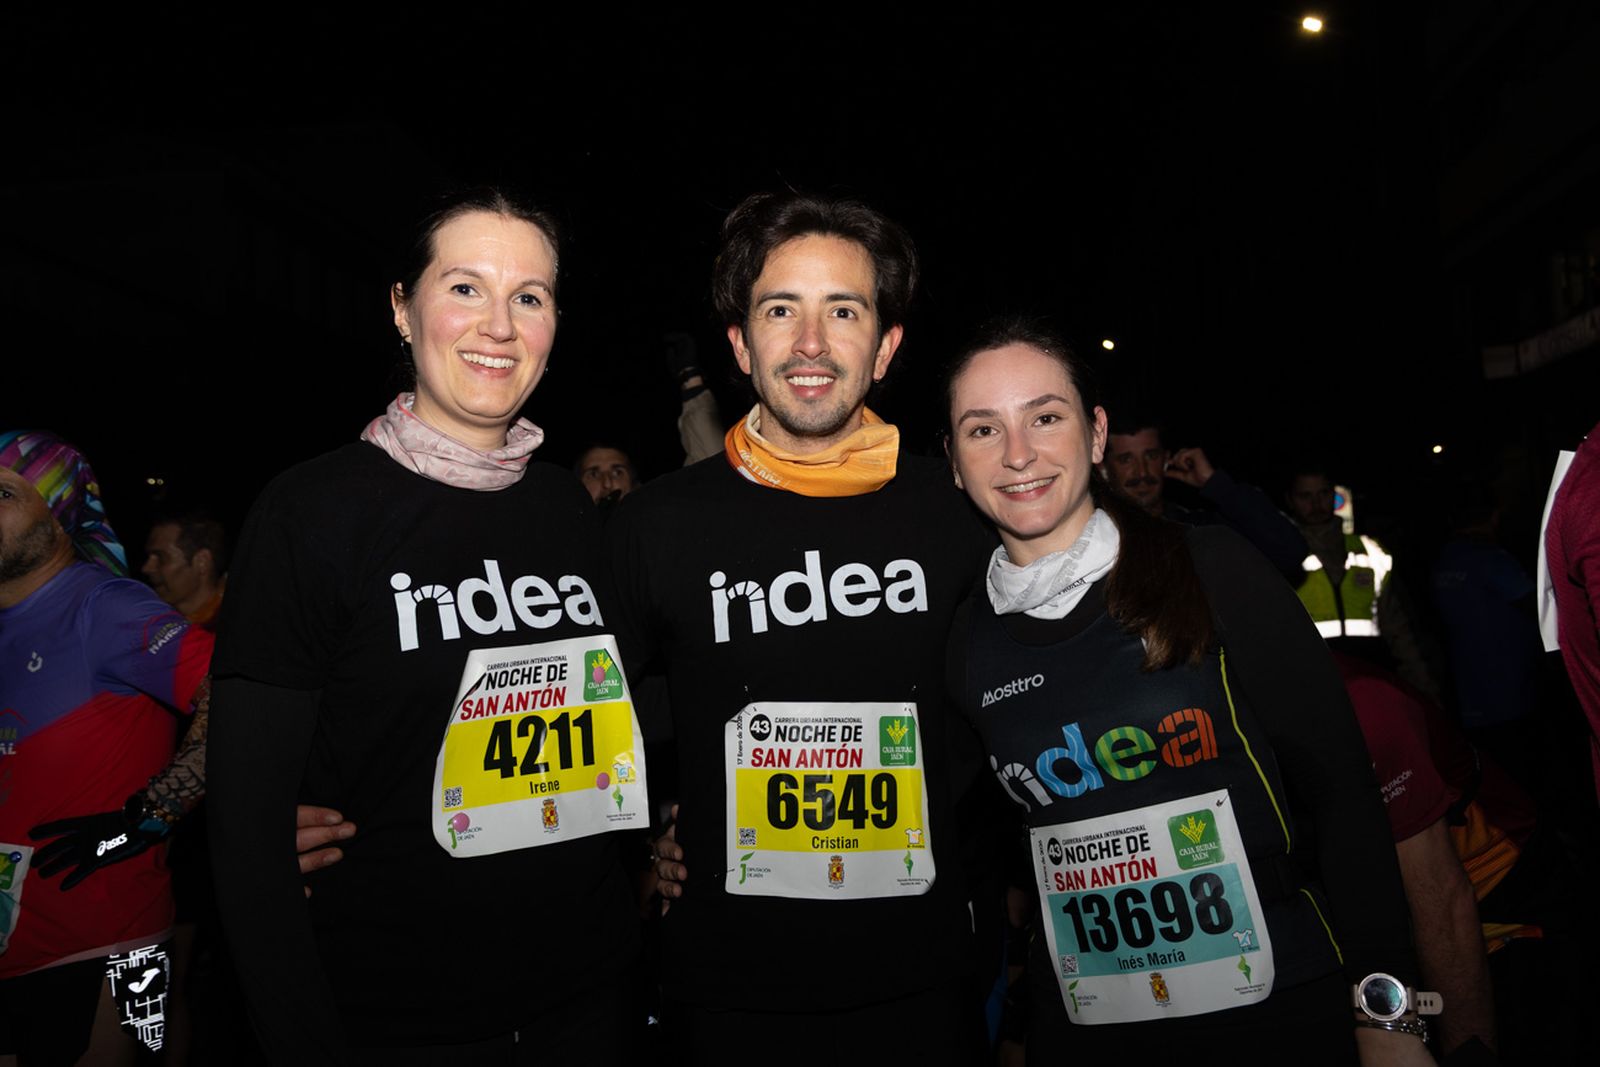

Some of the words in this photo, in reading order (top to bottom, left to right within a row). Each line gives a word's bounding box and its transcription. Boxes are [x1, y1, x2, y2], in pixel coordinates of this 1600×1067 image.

[390, 559, 605, 652] indea
[709, 550, 929, 643] indea
[487, 661, 509, 671] CARRERA
[510, 659, 530, 668] URBANA
[530, 655, 568, 665] INTERNACIONAL
[486, 664, 541, 690] NOCHE
[546, 663, 568, 683] DE
[460, 694, 500, 721] SAN
[502, 683, 567, 714] ANTÓN
[981, 673, 1046, 708] Mosttro
[750, 720, 770, 734] 43
[775, 725, 836, 743] NOCHE
[841, 725, 863, 743] DE
[483, 709, 595, 779] 4211
[751, 748, 792, 768] SAN
[795, 743, 863, 768] ANTÓN
[529, 780, 560, 795] Irene
[766, 772, 898, 831] 6549
[811, 835, 859, 849] Cristian
[1062, 836, 1082, 845] CARRERA
[1082, 832, 1103, 842] URBANA
[1104, 825, 1146, 838] INTERNACIONAL
[1048, 843, 1062, 858] 43
[1065, 838, 1123, 864] NOCHE
[1126, 832, 1151, 854] DE
[1179, 846, 1195, 857] CAJA
[1191, 852, 1209, 863] JAÉN
[1054, 869, 1087, 892] SAN
[1091, 855, 1158, 889] ANTÓN
[1062, 872, 1234, 953] 13698
[1117, 955, 1144, 971] Inés
[1146, 948, 1186, 968] María
